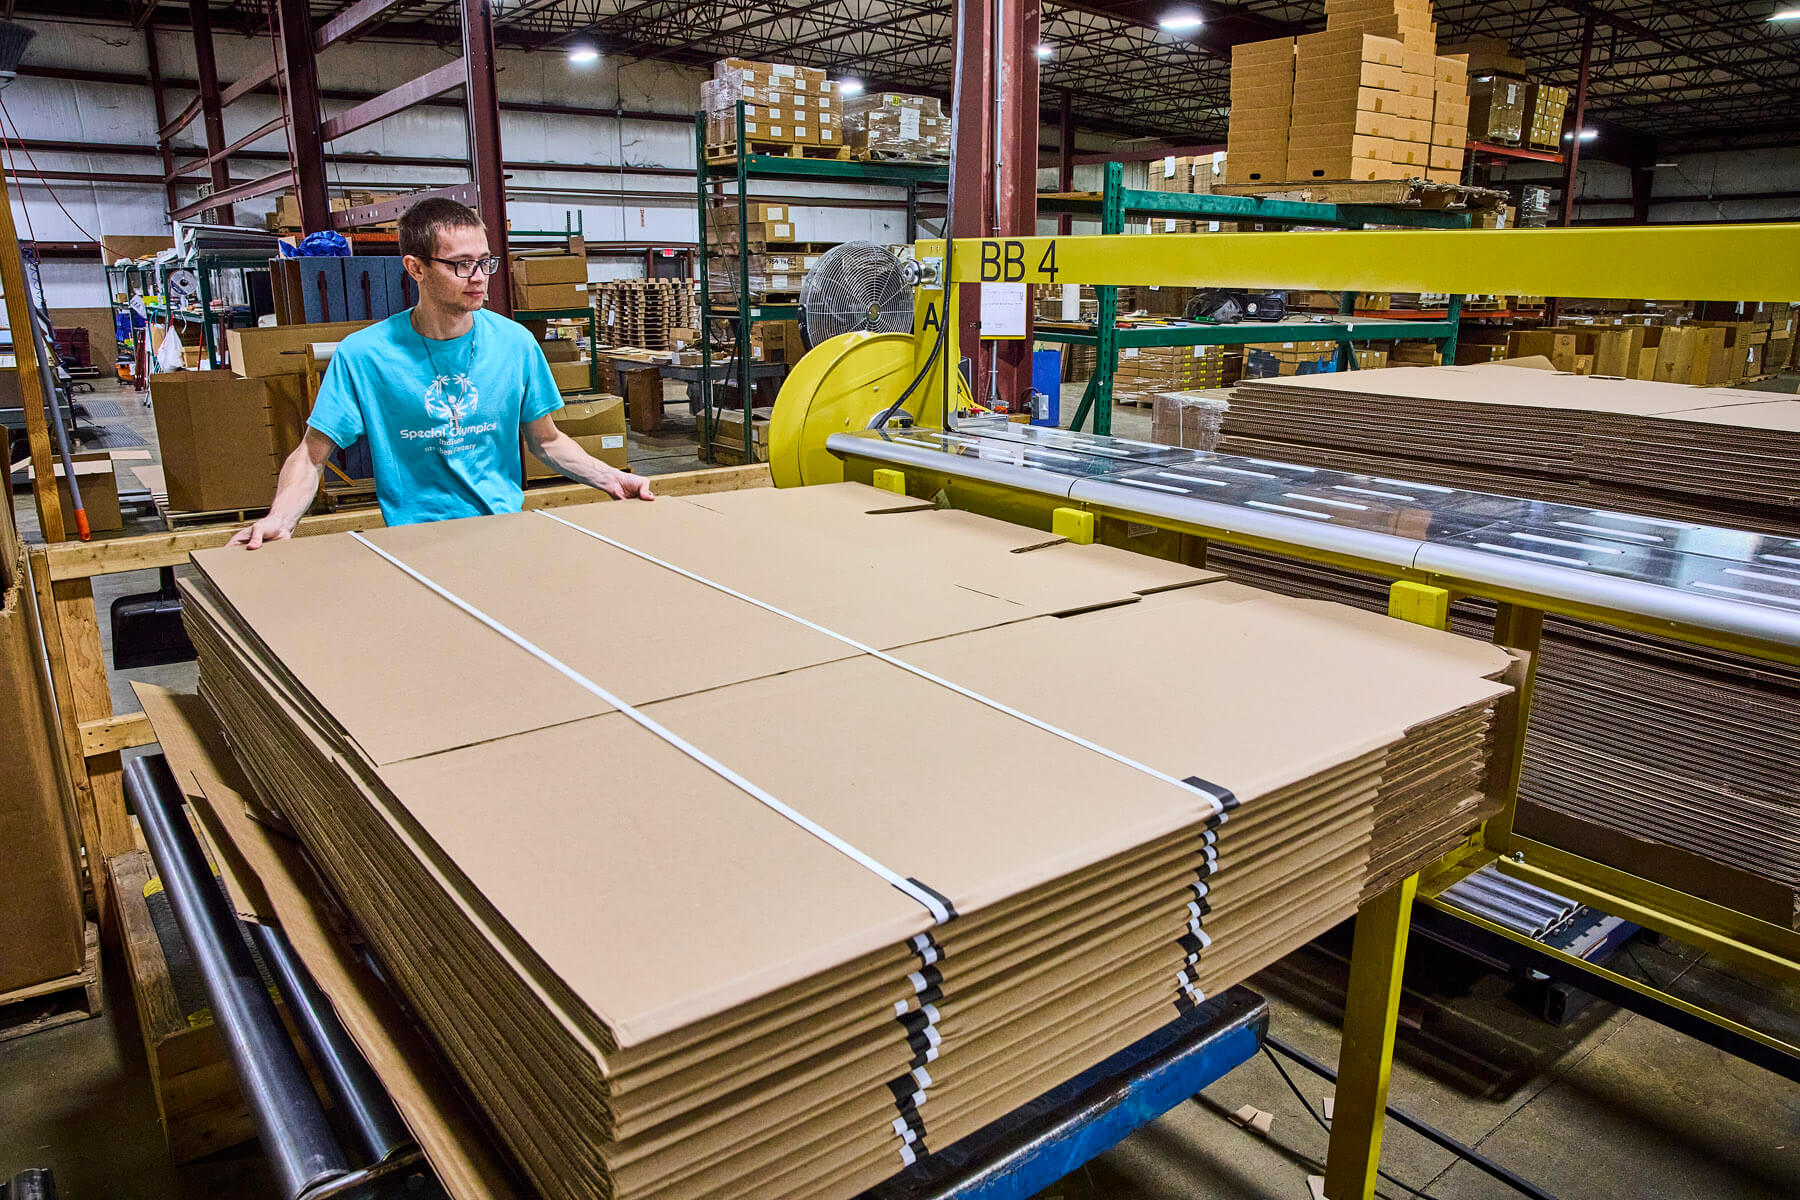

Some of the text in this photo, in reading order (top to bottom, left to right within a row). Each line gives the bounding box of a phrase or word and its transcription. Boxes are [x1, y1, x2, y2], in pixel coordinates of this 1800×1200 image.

[981, 240, 1059, 283] BB 4
[922, 302, 939, 332] A
[400, 422, 497, 440] Special Olympics
